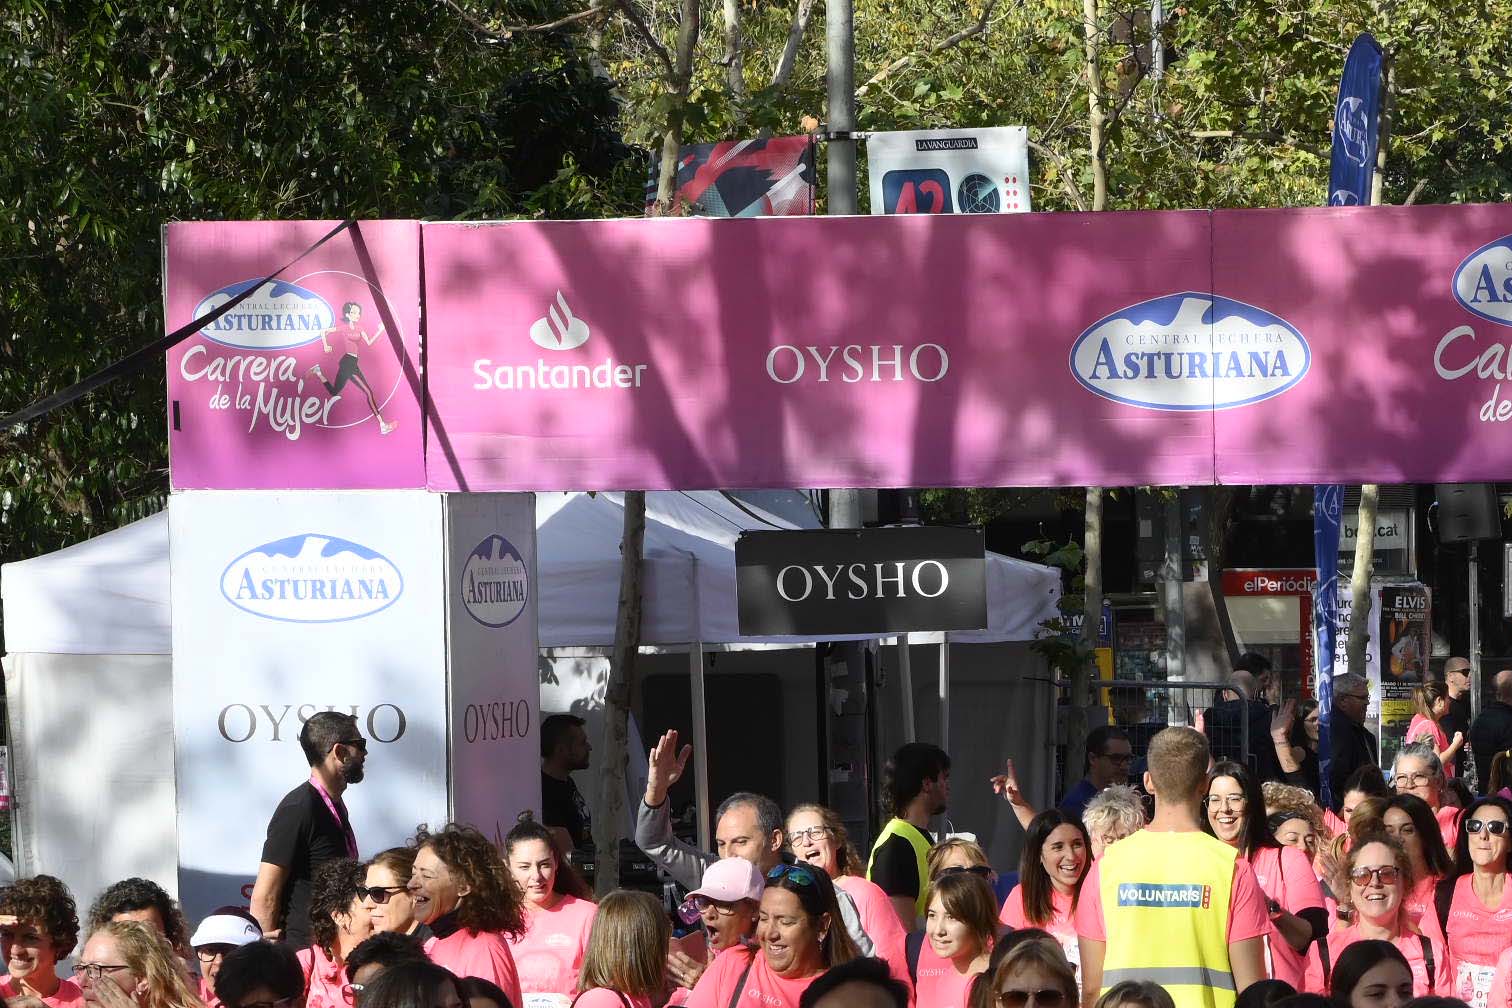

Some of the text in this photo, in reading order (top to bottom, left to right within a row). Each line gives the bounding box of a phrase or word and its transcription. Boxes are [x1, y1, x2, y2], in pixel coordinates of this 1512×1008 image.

[917, 139, 977, 150] LA VANGUARDIA
[203, 304, 322, 331] ASTURIANA
[1126, 331, 1284, 346] CENTRAL LECHERA
[180, 345, 297, 383] Carrera
[473, 359, 648, 391] Santander
[766, 344, 949, 384] OYSHO
[1090, 337, 1291, 380] ASTURIANA
[209, 379, 342, 440] de la Mujer
[1480, 385, 1512, 423] de
[236, 568, 390, 601] ASTURIANA
[467, 569, 525, 604] ASTURIANA
[776, 560, 950, 601] OYSHO
[1395, 596, 1425, 609] ELVIS
[464, 700, 530, 743] OYSHO
[1119, 888, 1200, 902] VOLUNTARIS
[749, 989, 783, 1007] OYSHO
